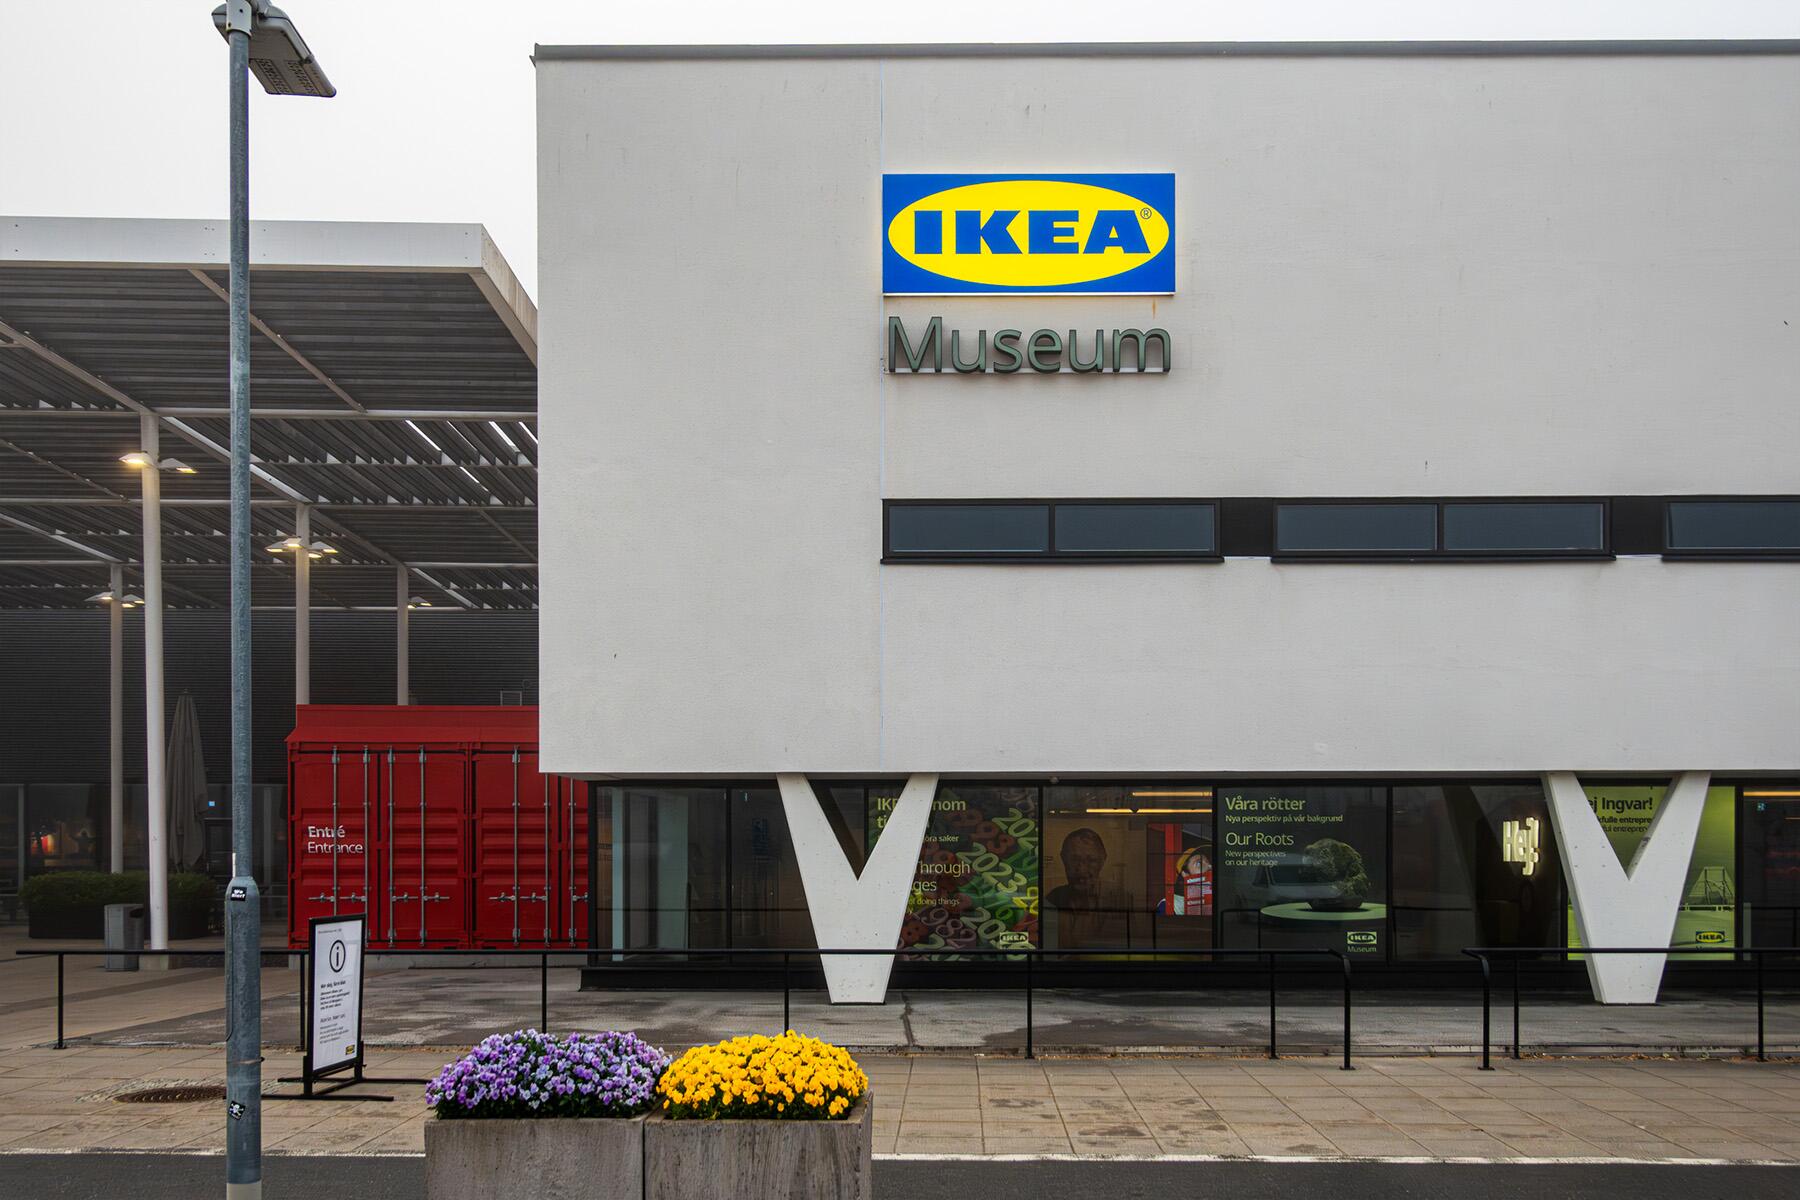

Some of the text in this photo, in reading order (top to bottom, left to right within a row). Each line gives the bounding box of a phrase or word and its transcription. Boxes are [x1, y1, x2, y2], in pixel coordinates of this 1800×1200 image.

[889, 316, 1171, 373] Museum
[1225, 795, 1306, 810] Våra rötter
[1602, 797, 1653, 814] Ingvar!
[1225, 814, 1343, 824] Nya perspektiv på vår bakgrund
[938, 834, 959, 842] saker
[1225, 832, 1294, 846] Our Roots
[1502, 817, 1539, 876] Hej!
[1243, 850, 1286, 859] perspectives
[918, 860, 970, 877] hrough
[1249, 859, 1279, 867] heritage
[912, 881, 937, 895] ges
[917, 897, 936, 907] doing
[938, 897, 960, 907] things
[1347, 945, 1377, 953] Museum
